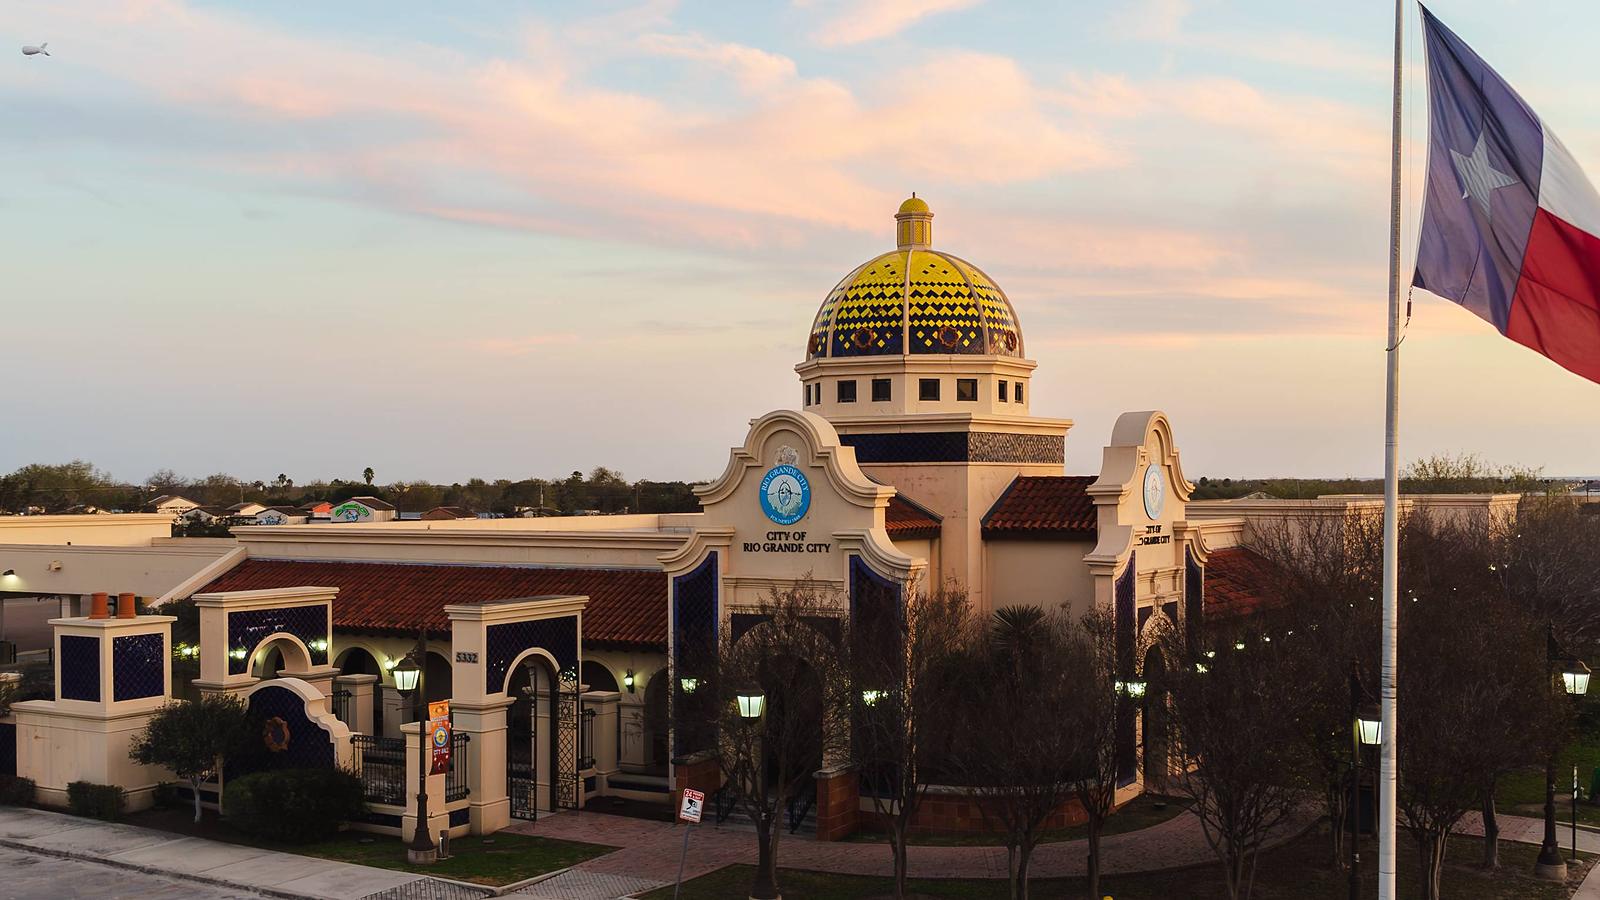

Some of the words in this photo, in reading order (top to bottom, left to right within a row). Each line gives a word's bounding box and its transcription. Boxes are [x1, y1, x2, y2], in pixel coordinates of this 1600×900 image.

[761, 477, 771, 491] RIO
[769, 466, 798, 479] GRANDE
[797, 473, 809, 491] CITY
[766, 531, 790, 541] CITY
[792, 531, 807, 541] OF
[743, 543, 760, 552] RIO
[762, 543, 804, 553] GRANDE
[806, 543, 831, 553] CITY
[456, 652, 478, 663] 5332
[685, 790, 693, 798] 24
